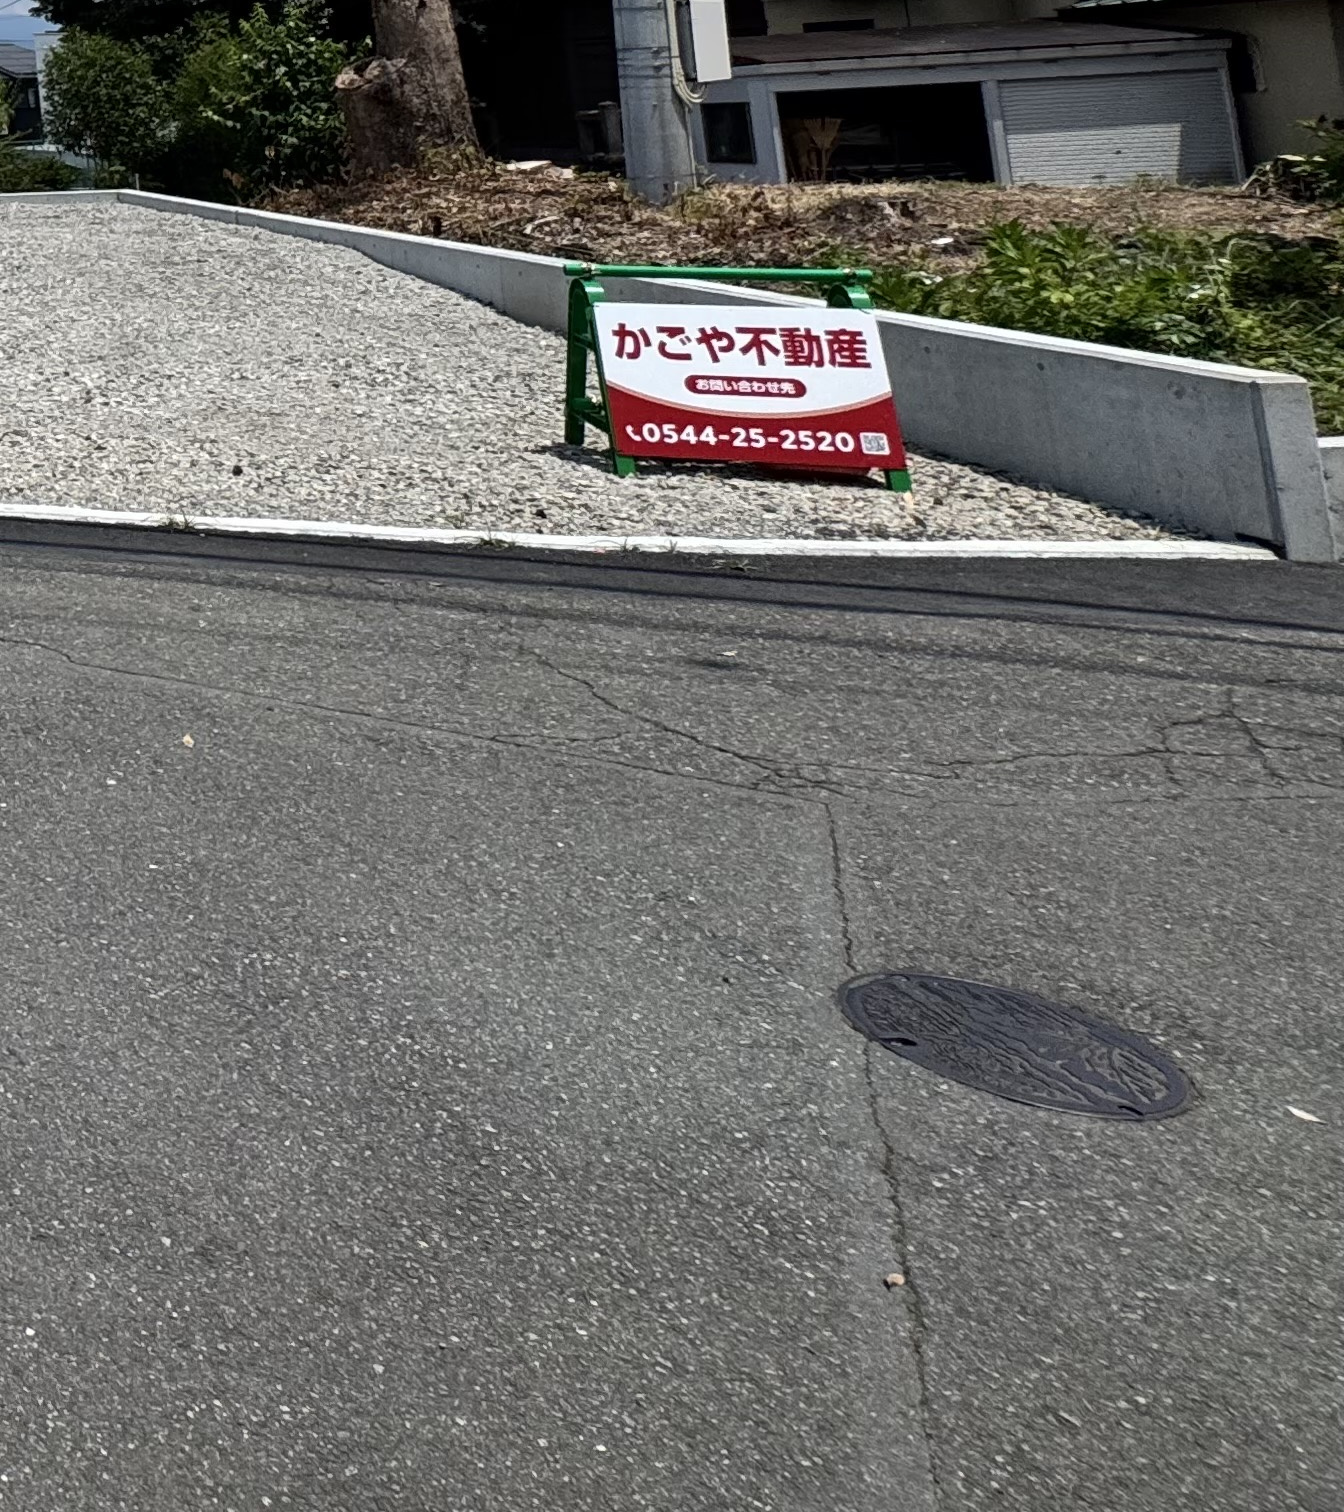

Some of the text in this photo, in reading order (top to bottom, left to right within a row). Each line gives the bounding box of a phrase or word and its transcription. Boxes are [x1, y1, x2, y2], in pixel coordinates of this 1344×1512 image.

[611, 322, 872, 368] かごや不動産
[695, 378, 796, 395] お問い合わせ先
[642, 422, 855, 453] 0544-25-2520
